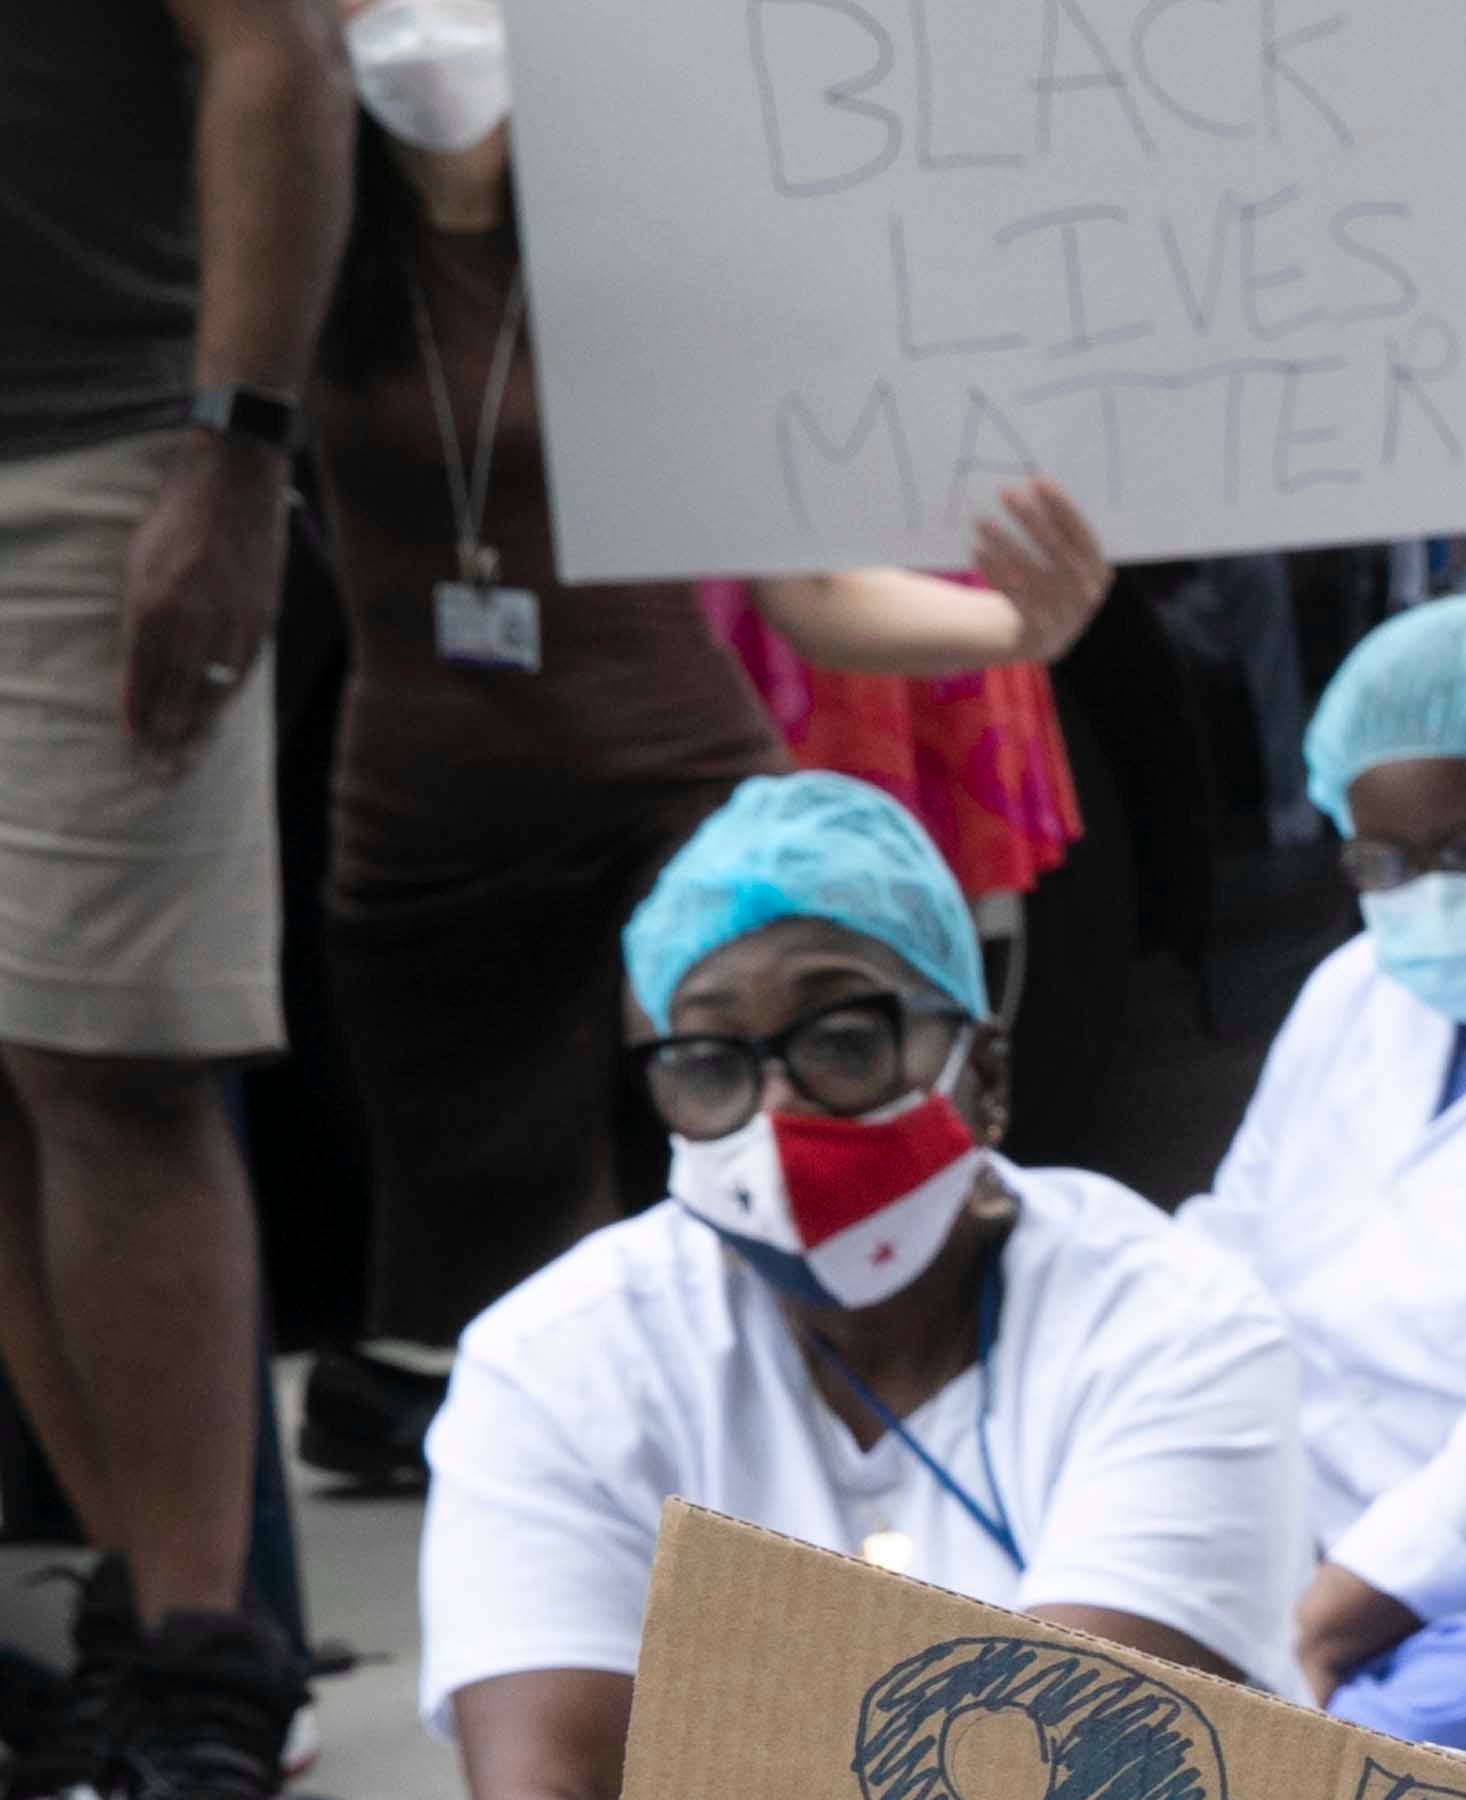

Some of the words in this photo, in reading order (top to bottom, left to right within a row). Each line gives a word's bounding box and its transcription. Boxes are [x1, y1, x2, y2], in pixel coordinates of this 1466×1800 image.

[747, 0, 1356, 198] BLACK
[888, 183, 1421, 362] LIVES
[773, 315, 1464, 534] MATTER
